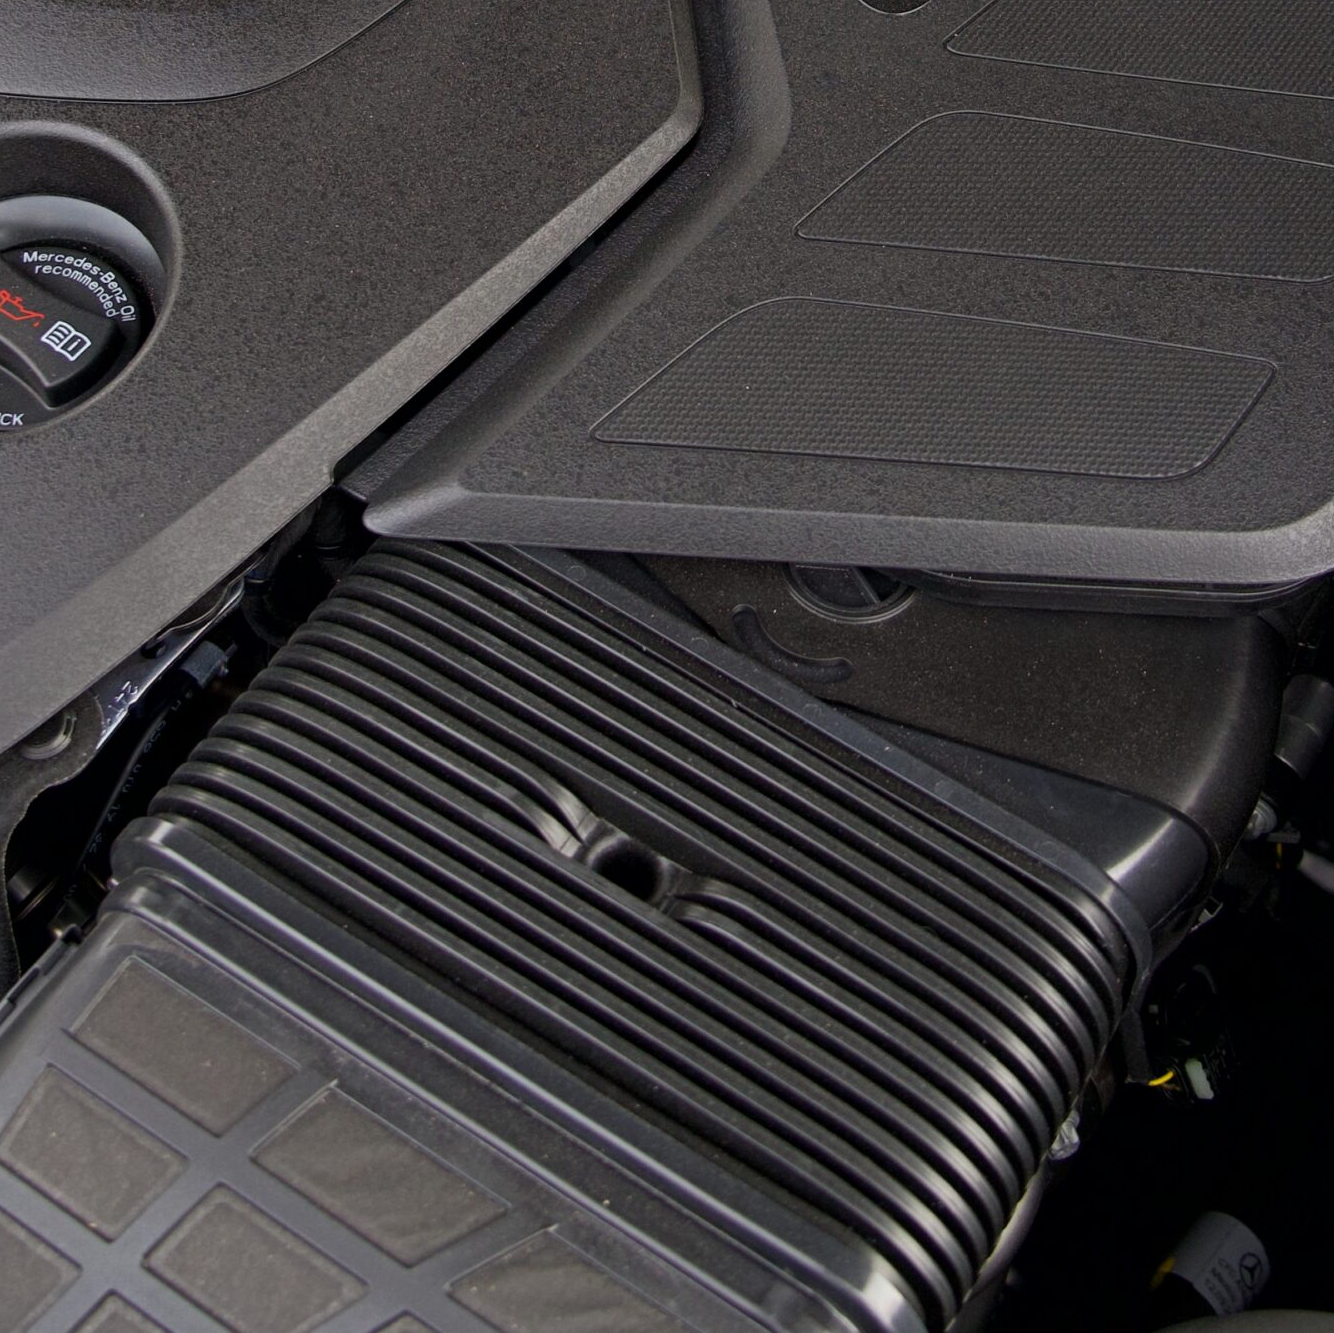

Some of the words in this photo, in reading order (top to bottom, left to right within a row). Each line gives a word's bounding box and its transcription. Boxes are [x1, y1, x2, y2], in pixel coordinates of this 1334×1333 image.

[23, 251, 127, 303] Mercedes-Benz
[121, 304, 136, 322] Oil
[35, 264, 118, 318] recommended
